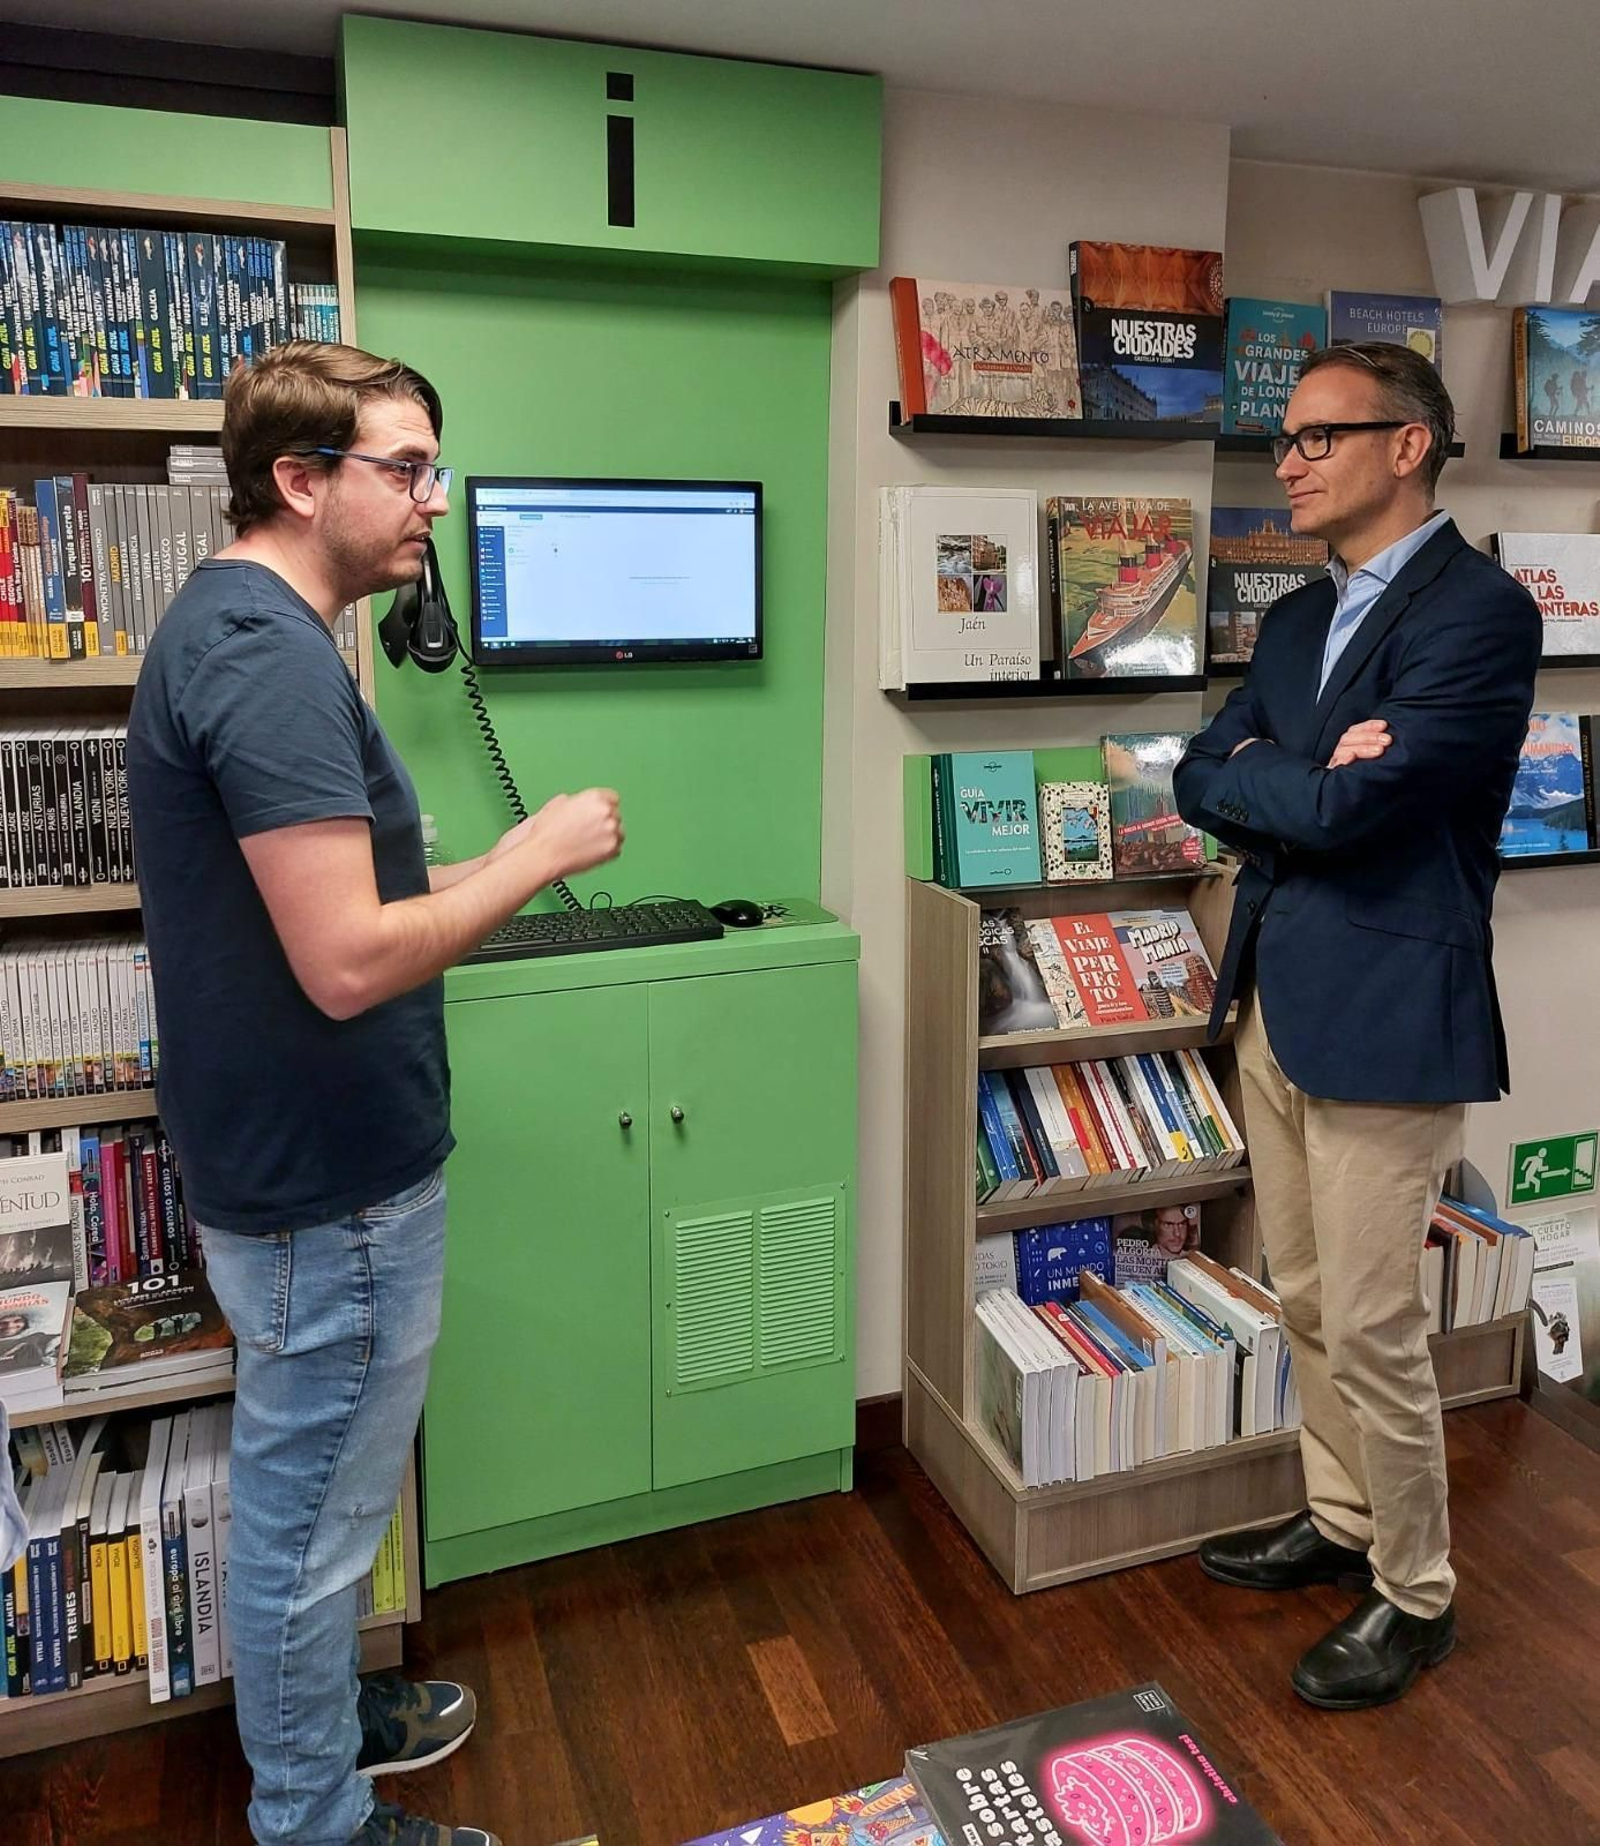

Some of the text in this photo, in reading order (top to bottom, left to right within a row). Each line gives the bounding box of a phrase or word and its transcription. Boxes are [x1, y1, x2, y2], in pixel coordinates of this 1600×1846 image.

[3, 283, 12, 307] TERUEL
[75, 274, 84, 296] LOIRA
[42, 270, 58, 348] AZUL DINAMARCA
[126, 286, 135, 320] VALENCIA
[132, 277, 142, 320] SANTANDER
[256, 296, 264, 323] TOLEDO
[278, 287, 286, 331] AUSTRALIA
[21, 283, 35, 347] AZUL URUGUAY
[72, 312, 81, 337] MIAMI
[79, 312, 88, 332] VALLE
[93, 291, 107, 350] AZUL BOLIVIA
[148, 288, 161, 349] AZUL GALICIA
[182, 293, 193, 352] AZUL HUESCA
[242, 301, 250, 328] MALTA
[1349, 307, 1425, 323] BEACH HOTELS
[0, 323, 9, 344] AZUL
[68, 331, 74, 340] DE
[87, 313, 97, 347] ALICANTE
[109, 330, 118, 350] AZUL
[119, 330, 129, 352] AZUL
[1111, 318, 1197, 343] NUESTRAS
[1257, 332, 1277, 344] LOS
[13, 302, 28, 385] TORONTO MONTREAL
[201, 334, 211, 354] AZUL
[952, 340, 1050, 365] ATRAMENTO
[1113, 335, 1195, 359] CIUDADES
[1245, 344, 1309, 362] GRANDES
[1234, 360, 1299, 385] VIAJE
[1241, 385, 1296, 399] DE LONE
[1240, 400, 1288, 419] PLAN
[1562, 434, 1600, 446] EUROP
[1082, 498, 1170, 511] LA AVENTURA DE
[42, 516, 51, 543] Santiago
[63, 505, 79, 577] Turquía secreta
[1081, 516, 1172, 541] VIAJAR
[109, 545, 121, 583] MADRID
[130, 535, 142, 601] REGIÓN DE MURCIA
[143, 553, 151, 579] VIENA
[161, 538, 173, 593] PAÍS VASCO
[176, 531, 190, 588] ORTUGAL
[81, 564, 92, 583] 101
[96, 528, 110, 623] COMUNIDAD VALENCIANA
[1234, 572, 1306, 588] NUESTRAS
[1513, 568, 1556, 583] ATLAS
[7, 575, 16, 606] SEGOVIA
[1237, 585, 1296, 603] CIUDAD
[1537, 585, 1564, 600] LAS
[1534, 601, 1598, 616] ONTERAS
[958, 616, 985, 634] Jaén
[964, 652, 1032, 666] Un Paraíso
[990, 668, 1032, 681] interior
[104, 769, 118, 829] NUEVA YORK
[117, 769, 130, 828] NUEVA YORK
[960, 786, 984, 798] GUÍA
[32, 785, 44, 832] ASTURIAS
[59, 793, 69, 831] CANTABRIA
[71, 780, 86, 831] TAILANDIA
[92, 798, 102, 824] INDIA
[960, 799, 1028, 824] VIVIR
[7, 812, 17, 833] CÁDIZ
[21, 810, 31, 832] CÁDIZ
[46, 807, 57, 831] PARÍS
[992, 824, 1030, 836] MEJOR
[1072, 955, 1120, 972] PER
[1079, 971, 1120, 987] FEC
[1089, 987, 1117, 1003] TO
[0, 1192, 60, 1214] ENTUD
[161, 1168, 178, 1239] CIELOS OSCUROS
[87, 1191, 100, 1242] Hola, Corea
[139, 1211, 148, 1236] NEVADA
[1538, 1222, 1571, 1234] CUERPO
[69, 1199, 85, 1281] TABERNAS DE MADRID
[150, 1222, 158, 1255] FLORENCIA
[1117, 1238, 1149, 1247] PEDRO
[1541, 1230, 1570, 1242] HOGAR
[1117, 1246, 1160, 1256] ALGORTA
[1117, 1255, 1134, 1264] LAS
[1047, 1261, 1105, 1279] UN MUNDO
[1117, 1264, 1151, 1273] SIGUEN
[127, 1275, 180, 1294] 101
[1048, 1273, 1105, 1292] INMEO
[131, 1538, 142, 1570] ISLANDIA
[166, 1548, 185, 1636] europa al aire libre
[188, 1550, 218, 1635] ISLANDIA
[4, 1592, 15, 1628] ALMERÍA
[65, 1591, 78, 1642] TRENES
[34, 1641, 45, 1662] ITALIA
[51, 1638, 63, 1668] FRANCIA
[956, 1768, 1004, 1837] sobre
[1001, 1761, 1062, 1846] asteles
